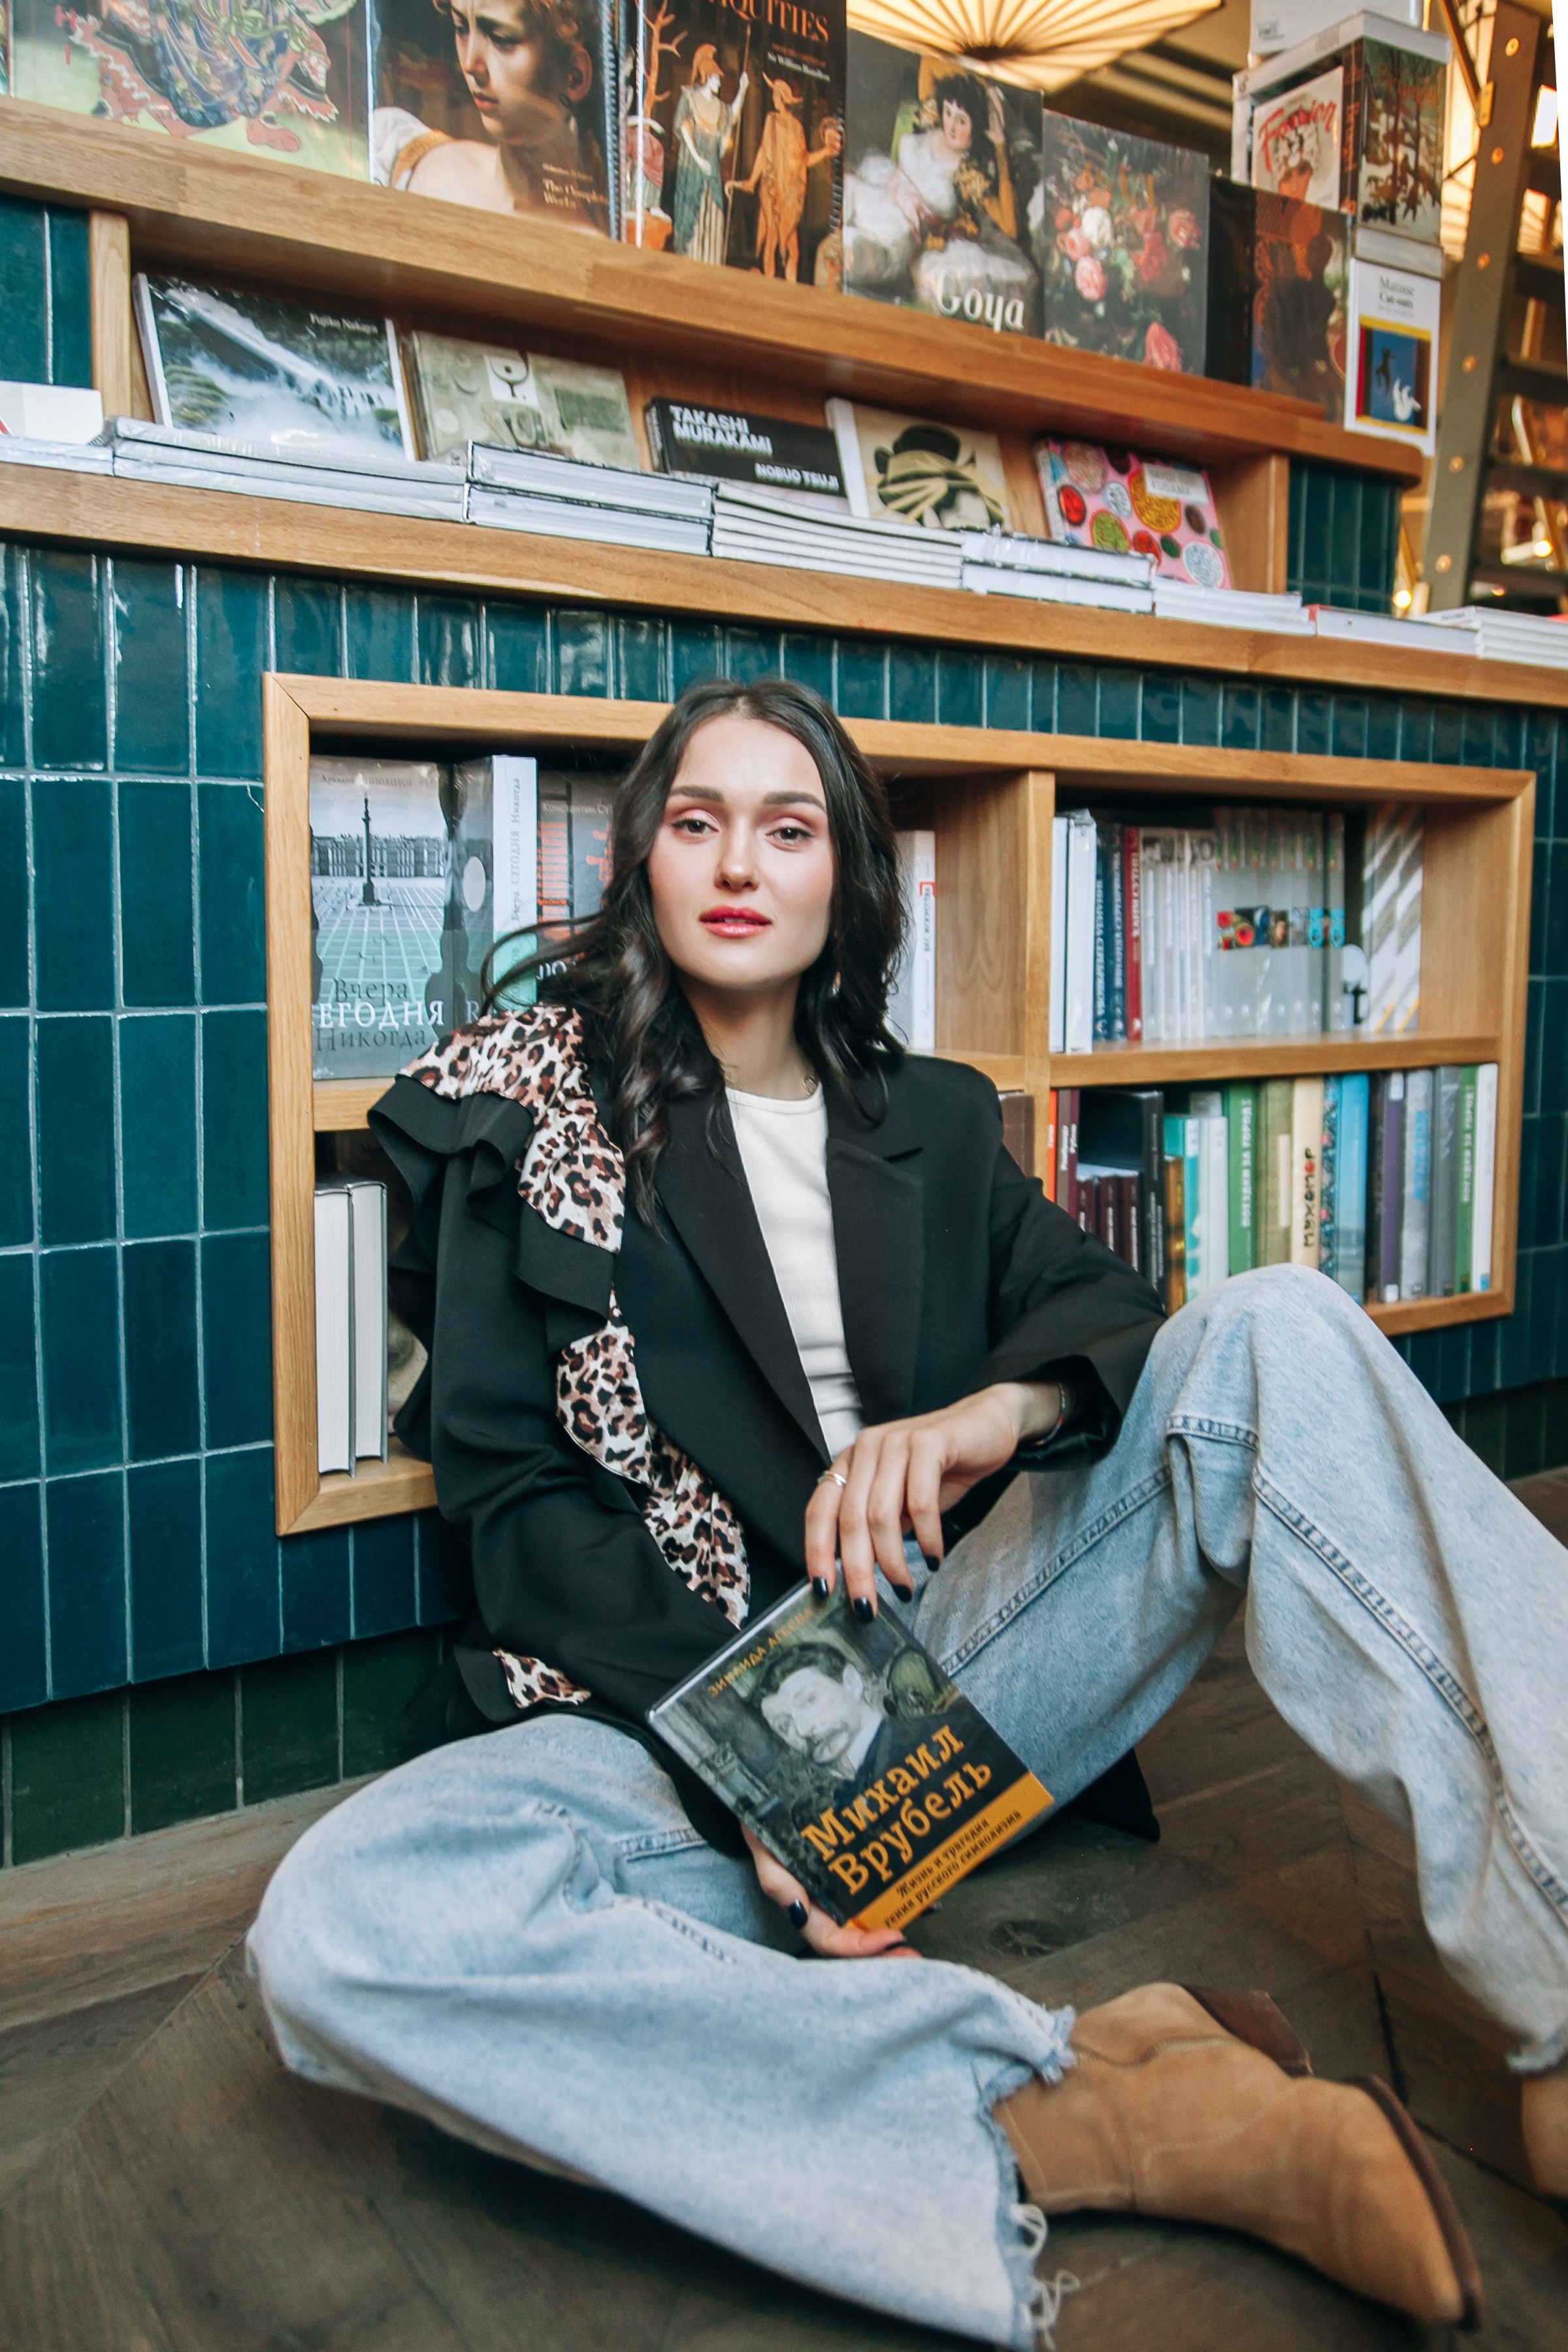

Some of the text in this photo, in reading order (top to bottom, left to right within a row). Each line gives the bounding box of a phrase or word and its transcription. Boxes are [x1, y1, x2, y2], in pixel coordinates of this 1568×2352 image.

[936, 265, 1024, 335] Goya
[669, 404, 750, 434] TAKASHI
[672, 420, 773, 456] MURAKAMI
[754, 462, 840, 491] NOBUO TSUJI
[334, 978, 408, 1007] Вчера
[312, 999, 444, 1032] ЕГОДНЯ
[316, 1027, 425, 1051] Никогда
[708, 1646, 768, 1698] ЗИНАИДА
[800, 1725, 965, 1862] Михаил
[828, 1761, 992, 1895] Врубель
[915, 1862, 960, 1904] русского
[959, 1810, 1023, 1863] символизма
[896, 1866, 934, 1898] Жизнь
